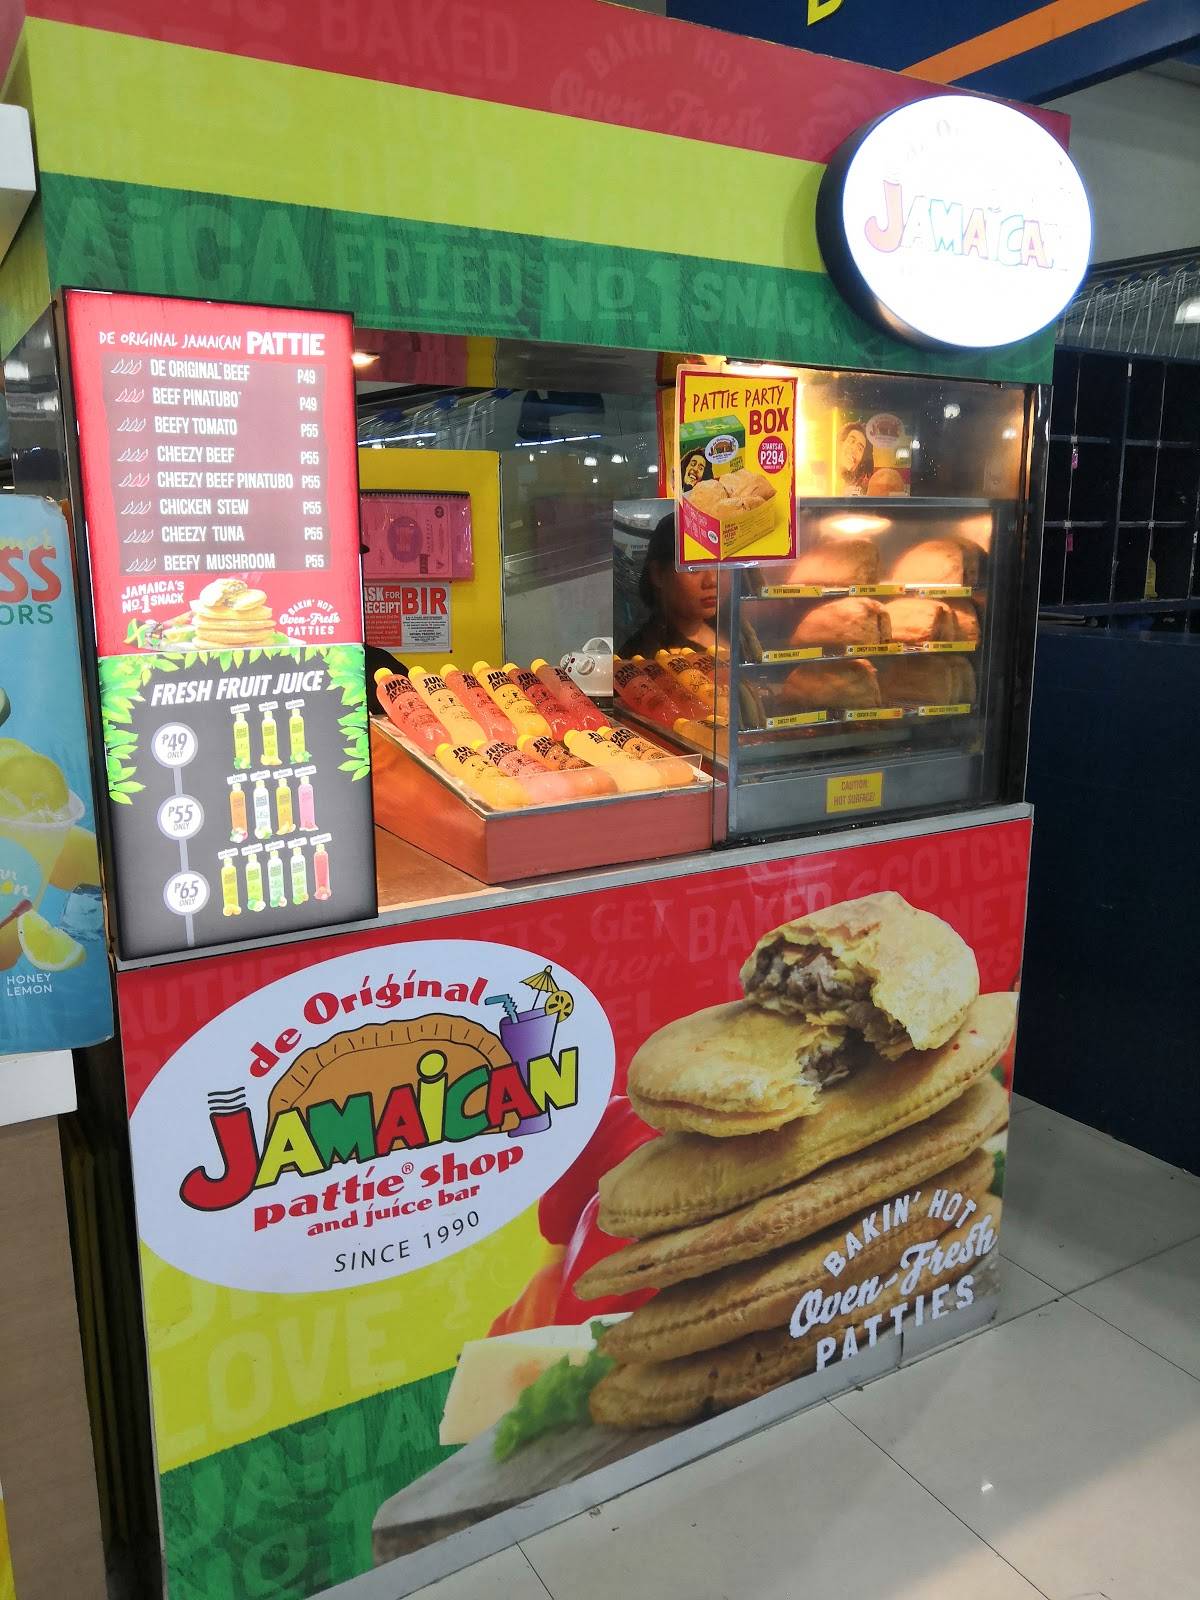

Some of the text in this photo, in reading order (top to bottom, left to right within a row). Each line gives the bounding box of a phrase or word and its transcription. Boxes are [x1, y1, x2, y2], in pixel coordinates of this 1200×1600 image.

[99, 331, 325, 356] DE ORIGINAL JAMAICAN PATTIE
[150, 359, 166, 376] DE
[223, 364, 250, 381] BEEF
[297, 369, 316, 384] P49
[152, 387, 180, 405] BEEF
[300, 397, 317, 411] P49
[693, 385, 785, 413] PATTIE PARTY
[154, 415, 318, 438] BEEFY TOMATO P55
[749, 407, 790, 435] BOX
[157, 445, 319, 465] CHEEZY BEEF P55
[760, 450, 785, 465] P294
[157, 471, 321, 490] CHEEZY BEEF PINATUBO P55
[159, 499, 322, 515] CHICKEN STEW P55
[161, 525, 323, 542] CHEEZY TUNA P55
[164, 553, 324, 571] BEEFY MUSHROOM P55
[121, 580, 185, 600] JAMAICA'S
[150, 592, 184, 606] SNACK
[385, 591, 401, 599] FOR
[401, 587, 448, 615] BIR
[287, 625, 335, 637] PATTIES
[150, 670, 325, 707] FRESH FRUIT JUICE
[833, 795, 847, 806] HOT
[7, 973, 52, 985] HONEY
[7, 984, 53, 997] LEMON
[248, 970, 488, 1078] de Original
[420, 1144, 525, 1188] shop
[306, 1184, 480, 1237] and juice bar
[333, 1210, 480, 1274] SINCE 1990
[823, 1189, 977, 1278] BAKIN' HOT
[789, 1214, 999, 1339] Oven-Fresh
[816, 1273, 975, 1372] PATTIES
